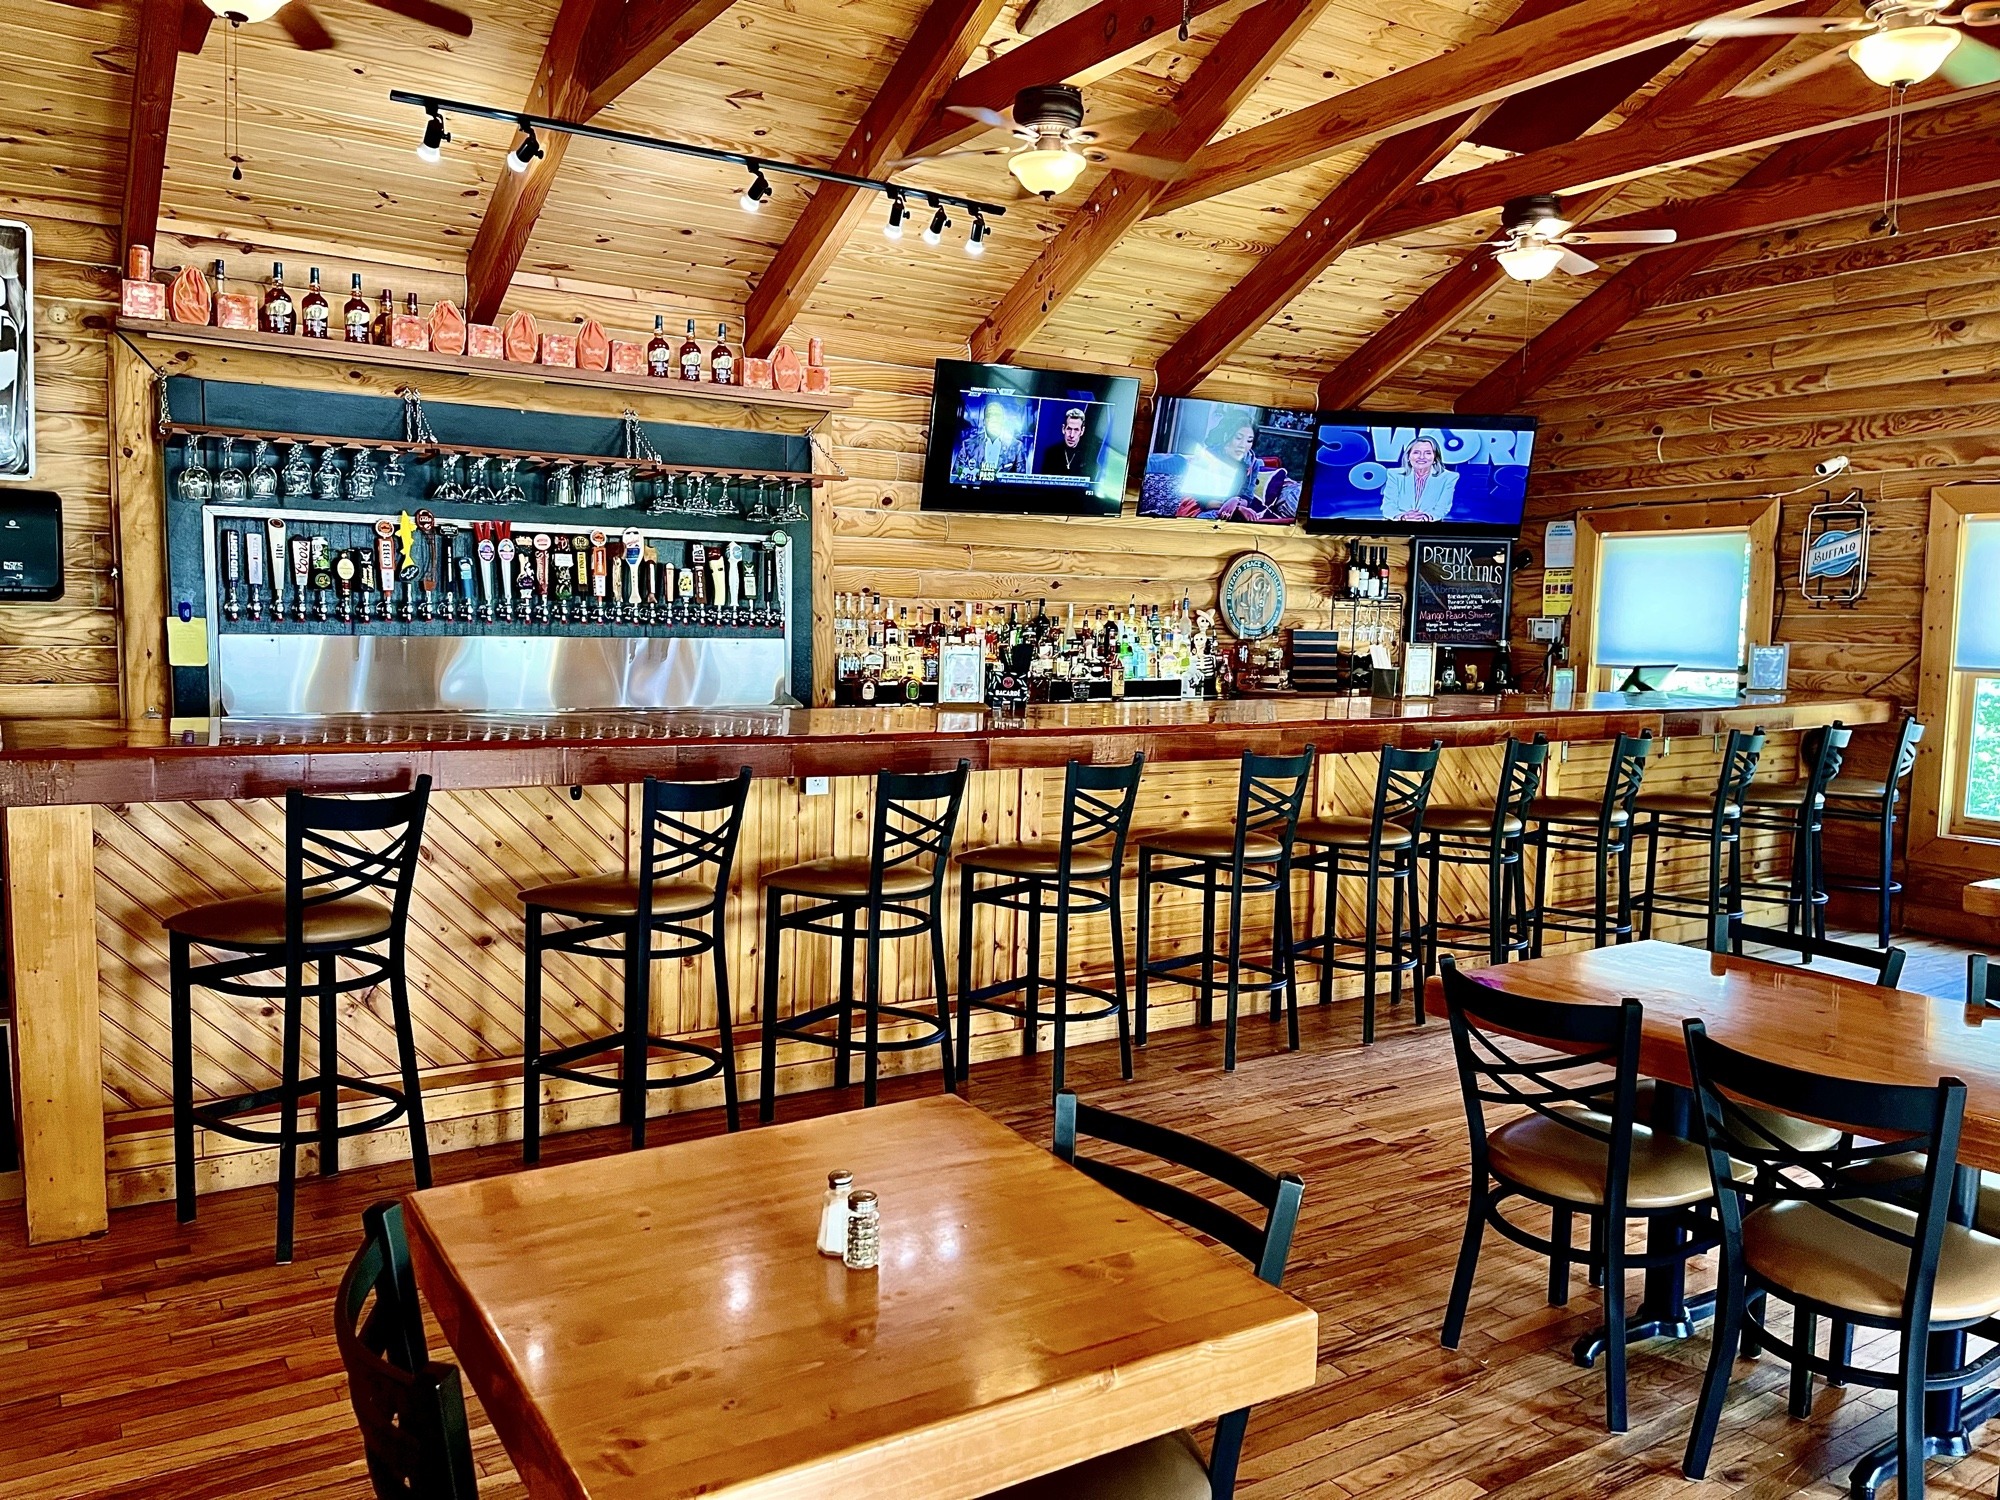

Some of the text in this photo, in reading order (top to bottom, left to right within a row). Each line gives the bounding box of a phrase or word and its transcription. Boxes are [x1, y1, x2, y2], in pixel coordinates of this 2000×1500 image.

[230, 534, 238, 578] BUD LIGHT
[295, 541, 309, 575] Coors
[1423, 546, 1474, 569] DRINK
[1813, 541, 1856, 566] BUFFALO
[1227, 560, 1282, 600] BUFFALO TRACE DISTILLERY
[1440, 564, 1502, 585] SPECIALS
[1419, 610, 1496, 622] Mango Peach Shooter
